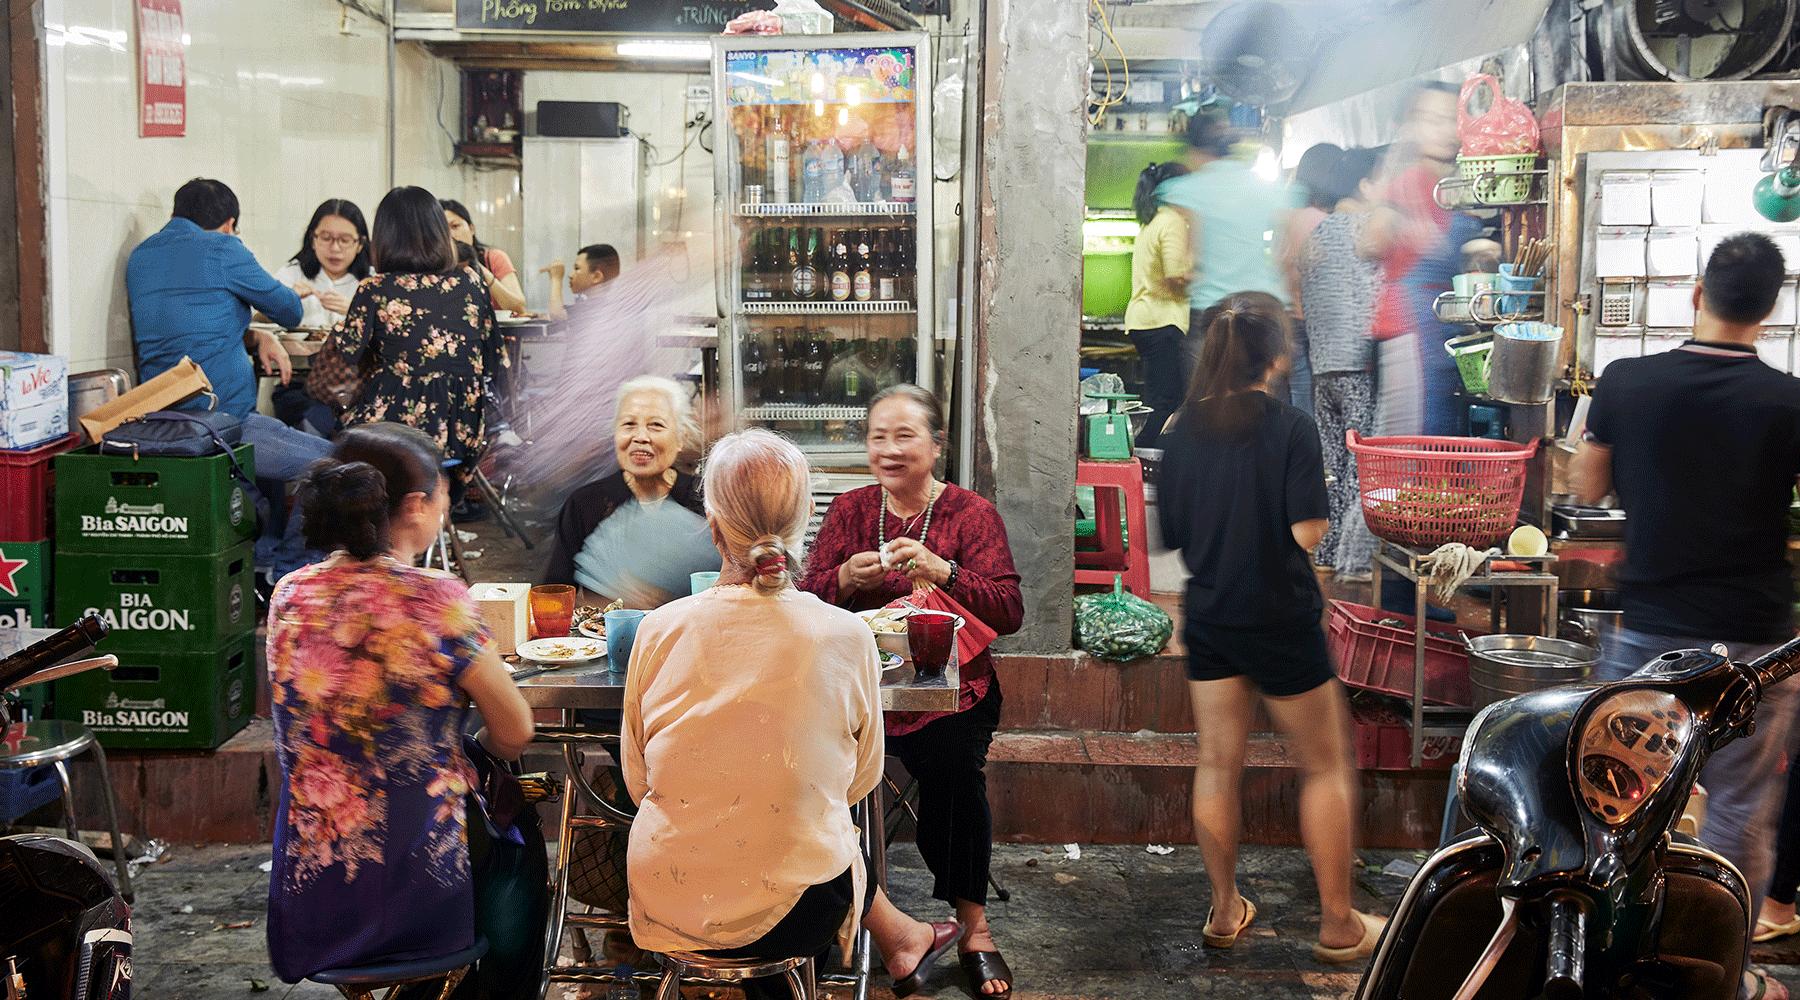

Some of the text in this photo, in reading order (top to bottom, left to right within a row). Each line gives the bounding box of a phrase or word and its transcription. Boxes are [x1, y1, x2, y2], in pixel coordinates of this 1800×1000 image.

[727, 51, 757, 61] SANYO
[81, 515, 188, 533] Bia SAIGON
[120, 593, 153, 607] BIA
[82, 710, 189, 727] Bia SAIGON
